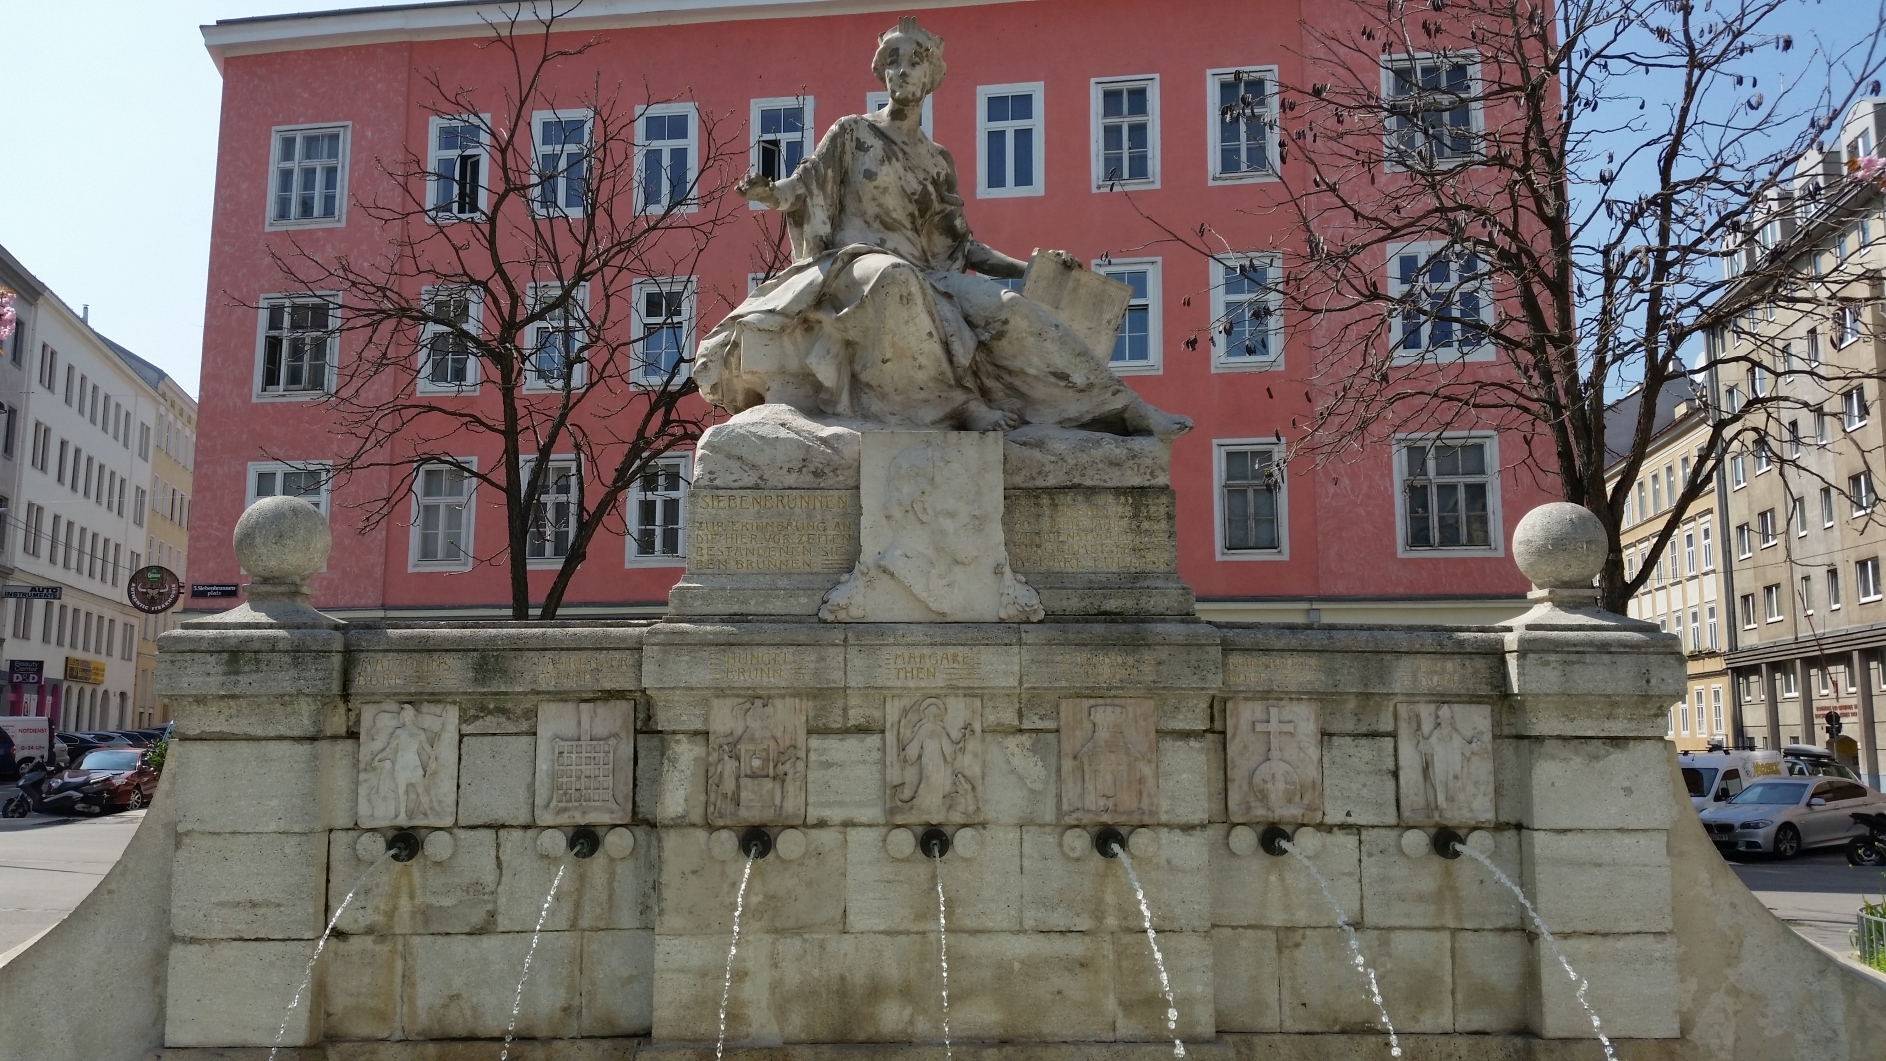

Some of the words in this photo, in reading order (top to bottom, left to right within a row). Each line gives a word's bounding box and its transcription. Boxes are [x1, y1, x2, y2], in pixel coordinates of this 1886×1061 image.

[700, 494, 848, 510] SIEBENBRUNNEN
[696, 520, 725, 532] ZUR
[731, 520, 828, 532] ERINNERUNG
[834, 520, 852, 532] AN
[695, 533, 717, 545] DIE
[724, 533, 758, 544] HIER
[764, 533, 791, 544] VOR
[798, 533, 852, 544] ZEITEN
[695, 546, 813, 557] BESTANDENEN
[695, 558, 729, 570] BEN
[735, 558, 813, 570] BRUNNEN
[1038, 556, 1085, 570] KARL
[1093, 556, 1167, 570] LUEGER
[4, 591, 58, 599] INSTRUMENTE
[14, 660, 39, 668] Beauty
[893, 652, 970, 666] MARGARE
[13, 673, 39, 682] D&D
[726, 667, 783, 680] BRUNN
[895, 667, 937, 680] THEN
